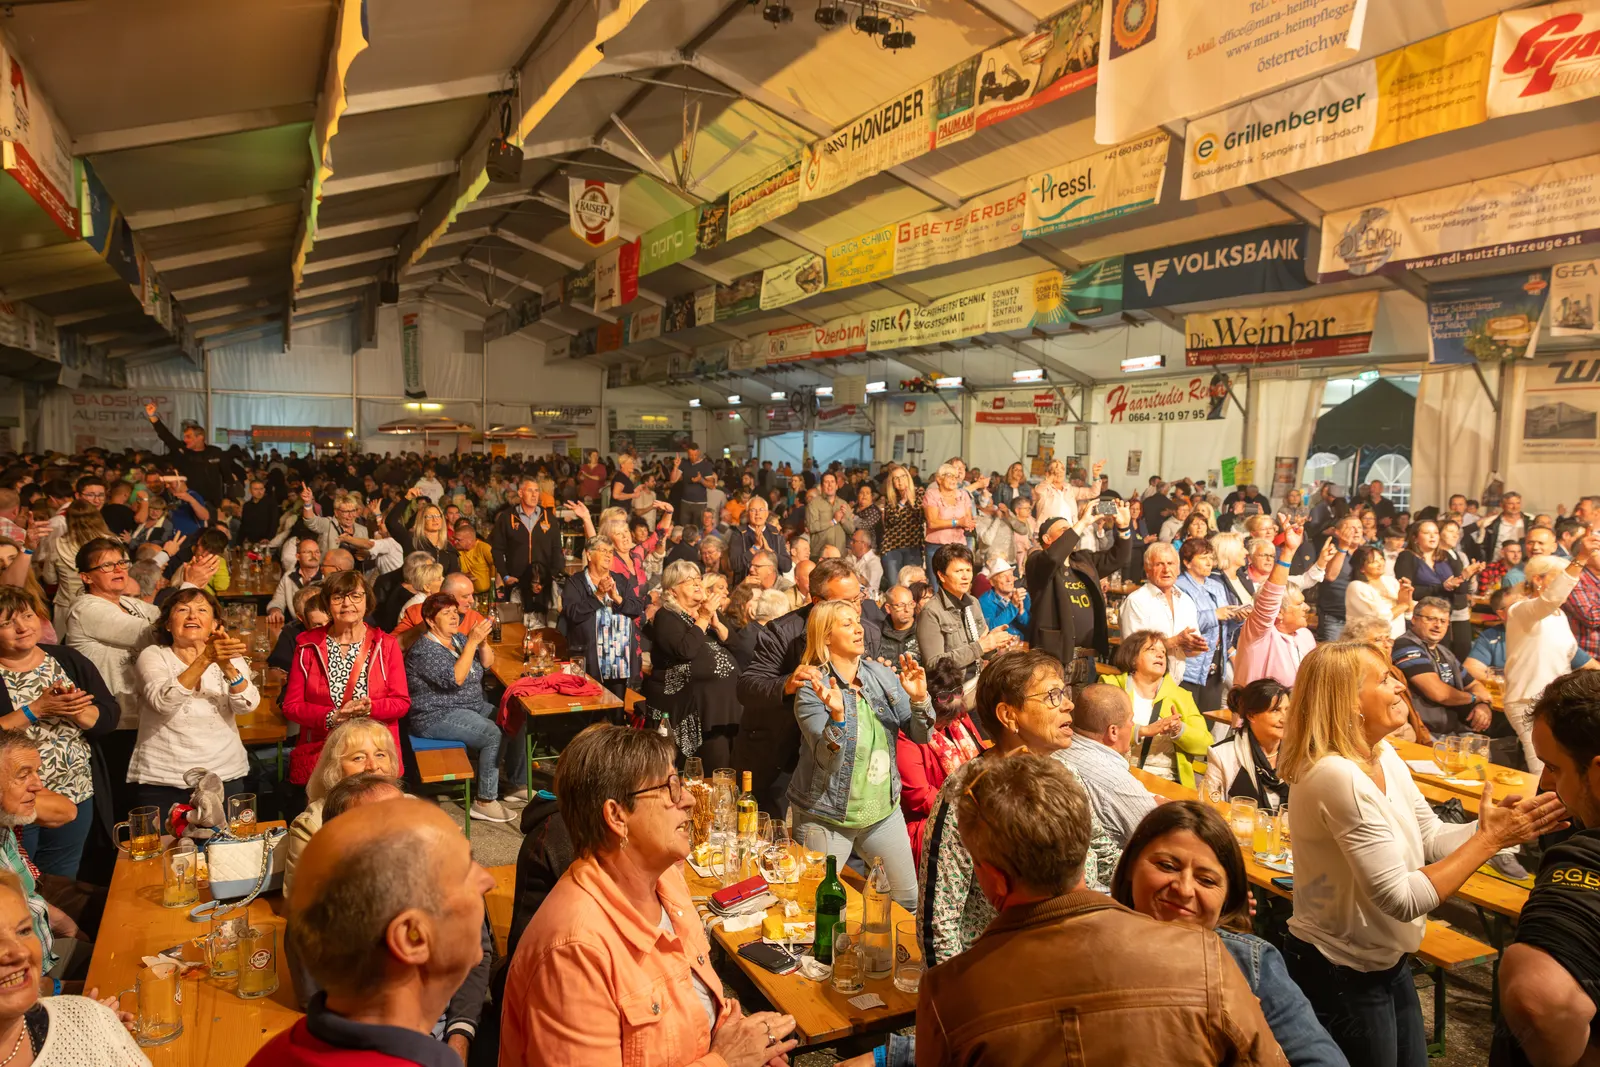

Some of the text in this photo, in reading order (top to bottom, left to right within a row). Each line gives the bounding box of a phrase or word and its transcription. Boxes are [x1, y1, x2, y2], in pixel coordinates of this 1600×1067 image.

[851, 88, 923, 152] HONEDER
[1223, 92, 1366, 151] Grillenberger
[1143, 138, 1153, 149] 53
[1192, 124, 1364, 180] Gebäudetechnik Spenglerei Flachdach
[579, 200, 607, 217] KAISER
[831, 241, 859, 258] ULRICH
[861, 229, 892, 246] SCHMID
[1405, 234, 1582, 270] www.redl-nutzfahrzeuge.at
[1173, 238, 1299, 276] VOLKSBANK
[992, 285, 1020, 299] SONNEN
[1035, 283, 1060, 295] SONNEN
[1036, 292, 1060, 302] SCHEIN
[992, 296, 1018, 309] SCHUTZ
[992, 304, 1024, 318] ZENTRUM
[870, 315, 897, 333] SITEK
[1212, 310, 1336, 348] Weinbar
[1189, 332, 1214, 349] Die
[1259, 350, 1280, 359] David
[71, 393, 168, 407] BADSHOP
[1106, 384, 1184, 424] Haarstudio
[1128, 412, 1150, 422] 0664
[1157, 411, 1175, 421] 210
[1177, 410, 1190, 420] 97
[1192, 409, 1205, 419] 95
[1069, 594, 1090, 609] 40
